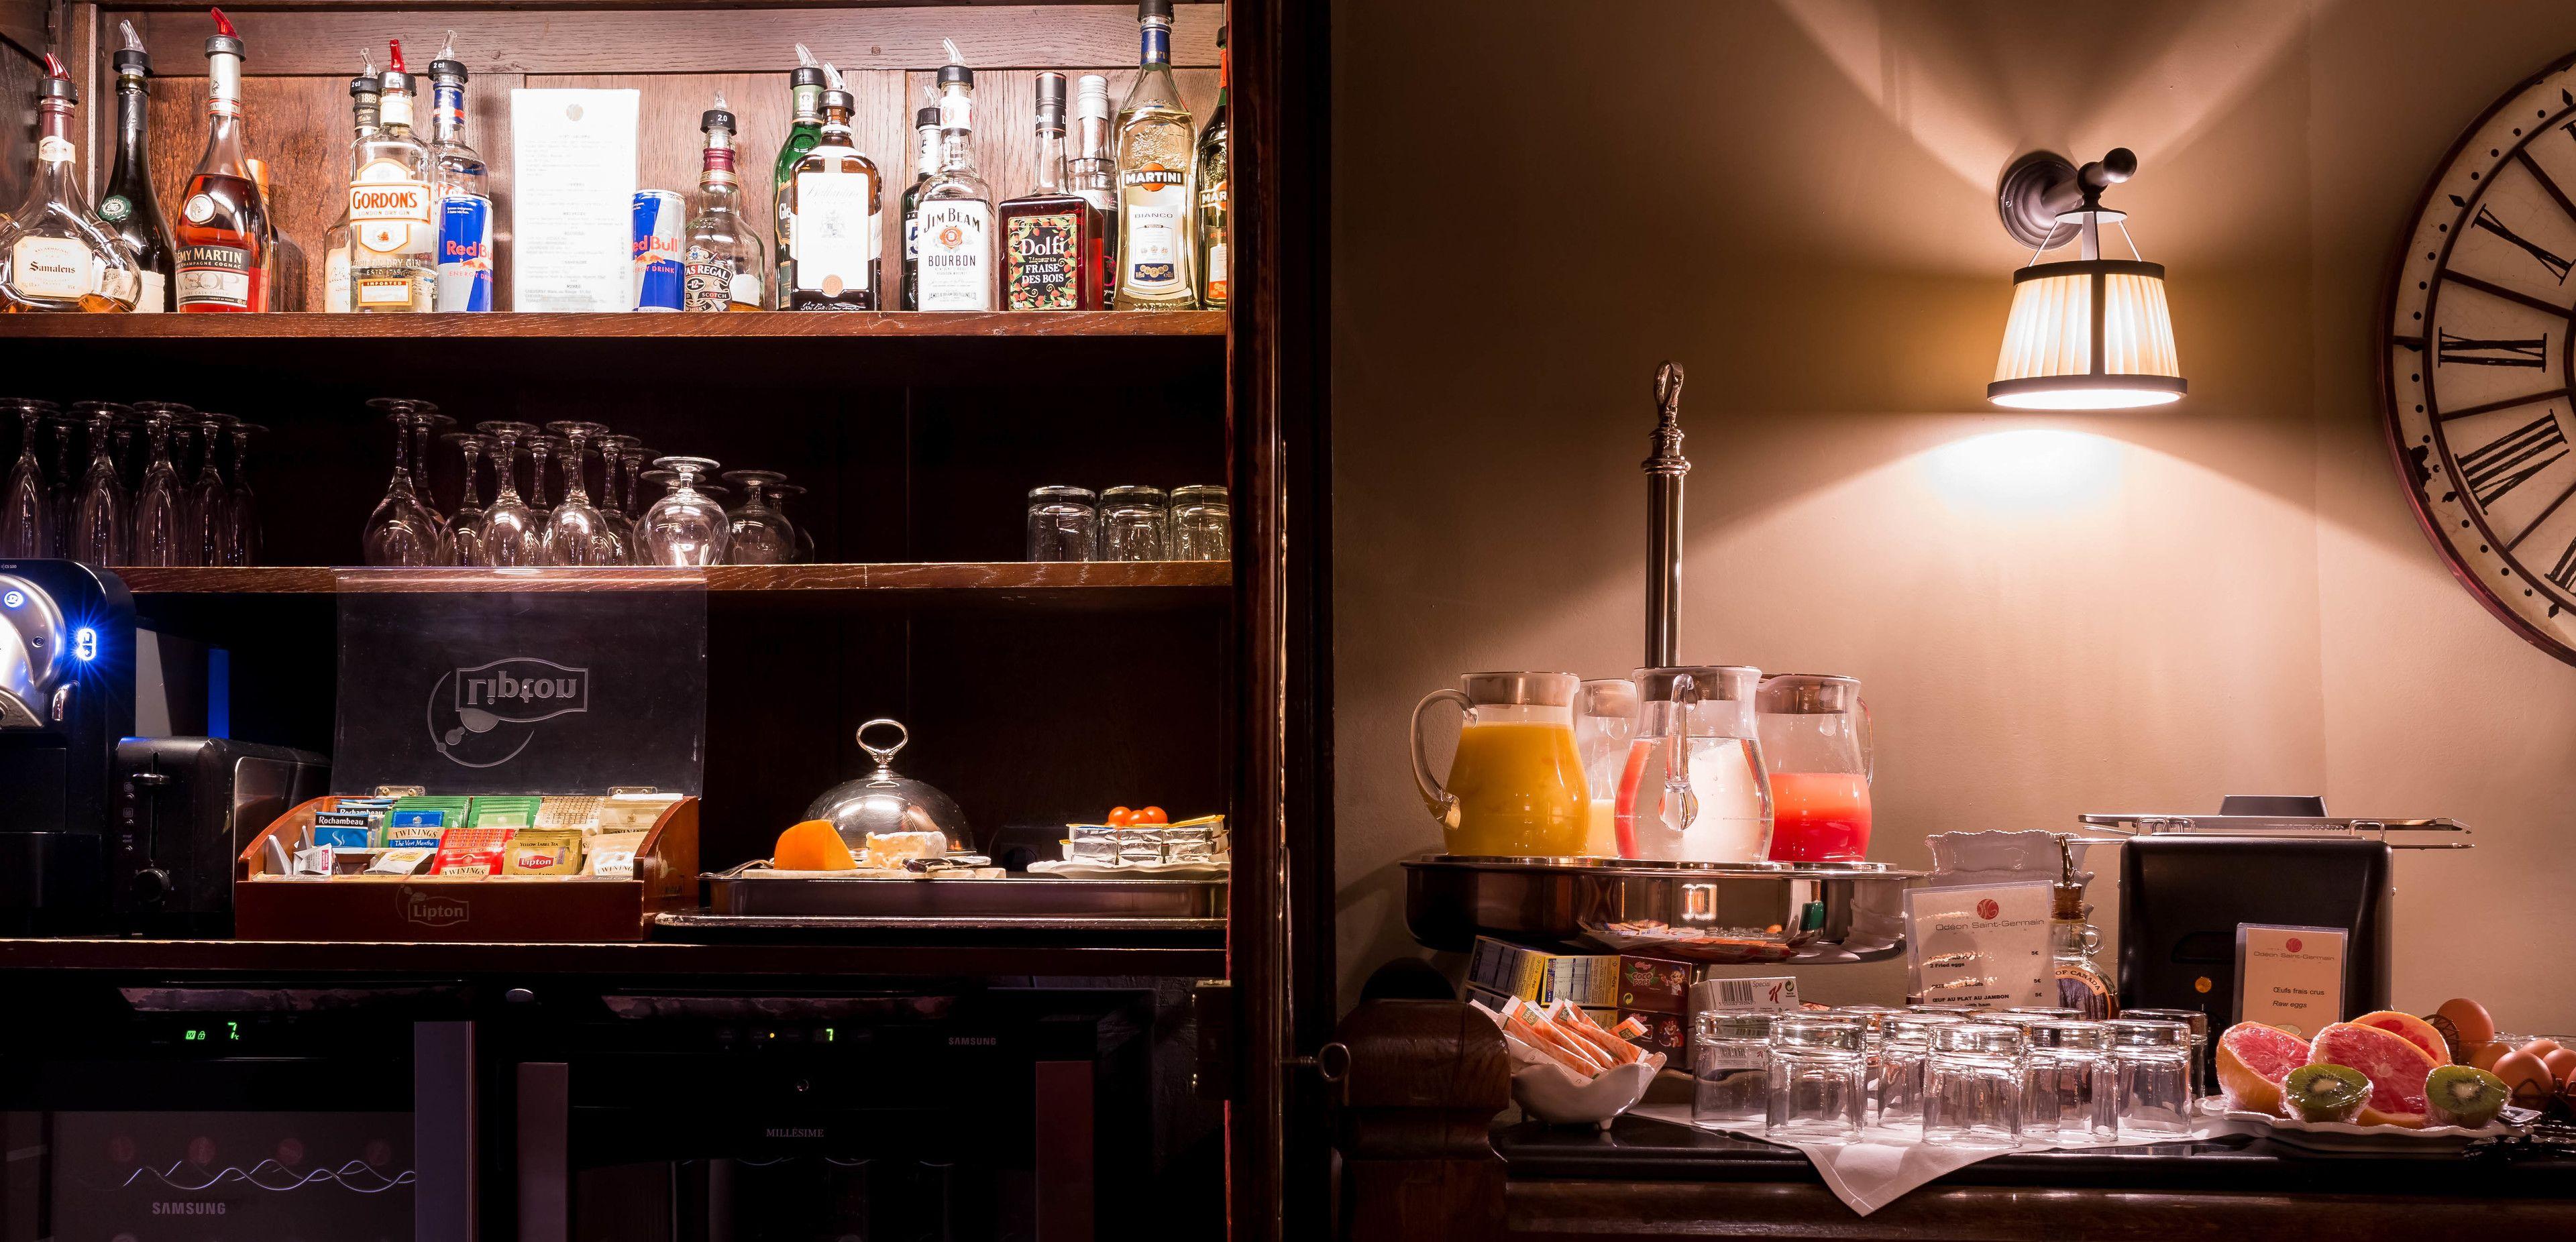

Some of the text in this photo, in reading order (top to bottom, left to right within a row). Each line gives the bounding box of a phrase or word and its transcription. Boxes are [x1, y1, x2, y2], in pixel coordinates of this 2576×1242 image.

[361, 93, 377, 103] 1889
[1126, 172, 1181, 184] MARTINI
[353, 191, 417, 209] GORDON'S
[924, 208, 980, 233] JIM BEAM
[447, 240, 477, 258] Red
[651, 235, 679, 253] Bull
[1021, 236, 1064, 256] Dolfi
[194, 247, 242, 264] MARTIN
[928, 255, 976, 267] BOURBON
[29, 261, 76, 274] Samalens
[651, 266, 675, 274] DRINK
[698, 265, 728, 280] REGAL
[1026, 264, 1060, 274] FRAISE
[1022, 274, 1064, 284] DES BOIS
[319, 816, 364, 826] Rochambeau
[394, 830, 439, 839] TWININGS
[521, 858, 551, 867] Lipton
[443, 868, 486, 876] TWININGS
[413, 905, 464, 921] Lipton
[1935, 919, 2045, 931] Odéon Saint-Germain
[2280, 952, 2334, 961] Saint-Germain
[1631, 972, 1654, 980] COCO
[2070, 970, 2100, 991] CANADA
[1752, 980, 1783, 1004] Special K
[228, 1022, 237, 1039] 7
[826, 1029, 833, 1041] 7
[948, 1037, 997, 1046] SAMSUNG
[152, 1202, 225, 1215] SAMSUNG
